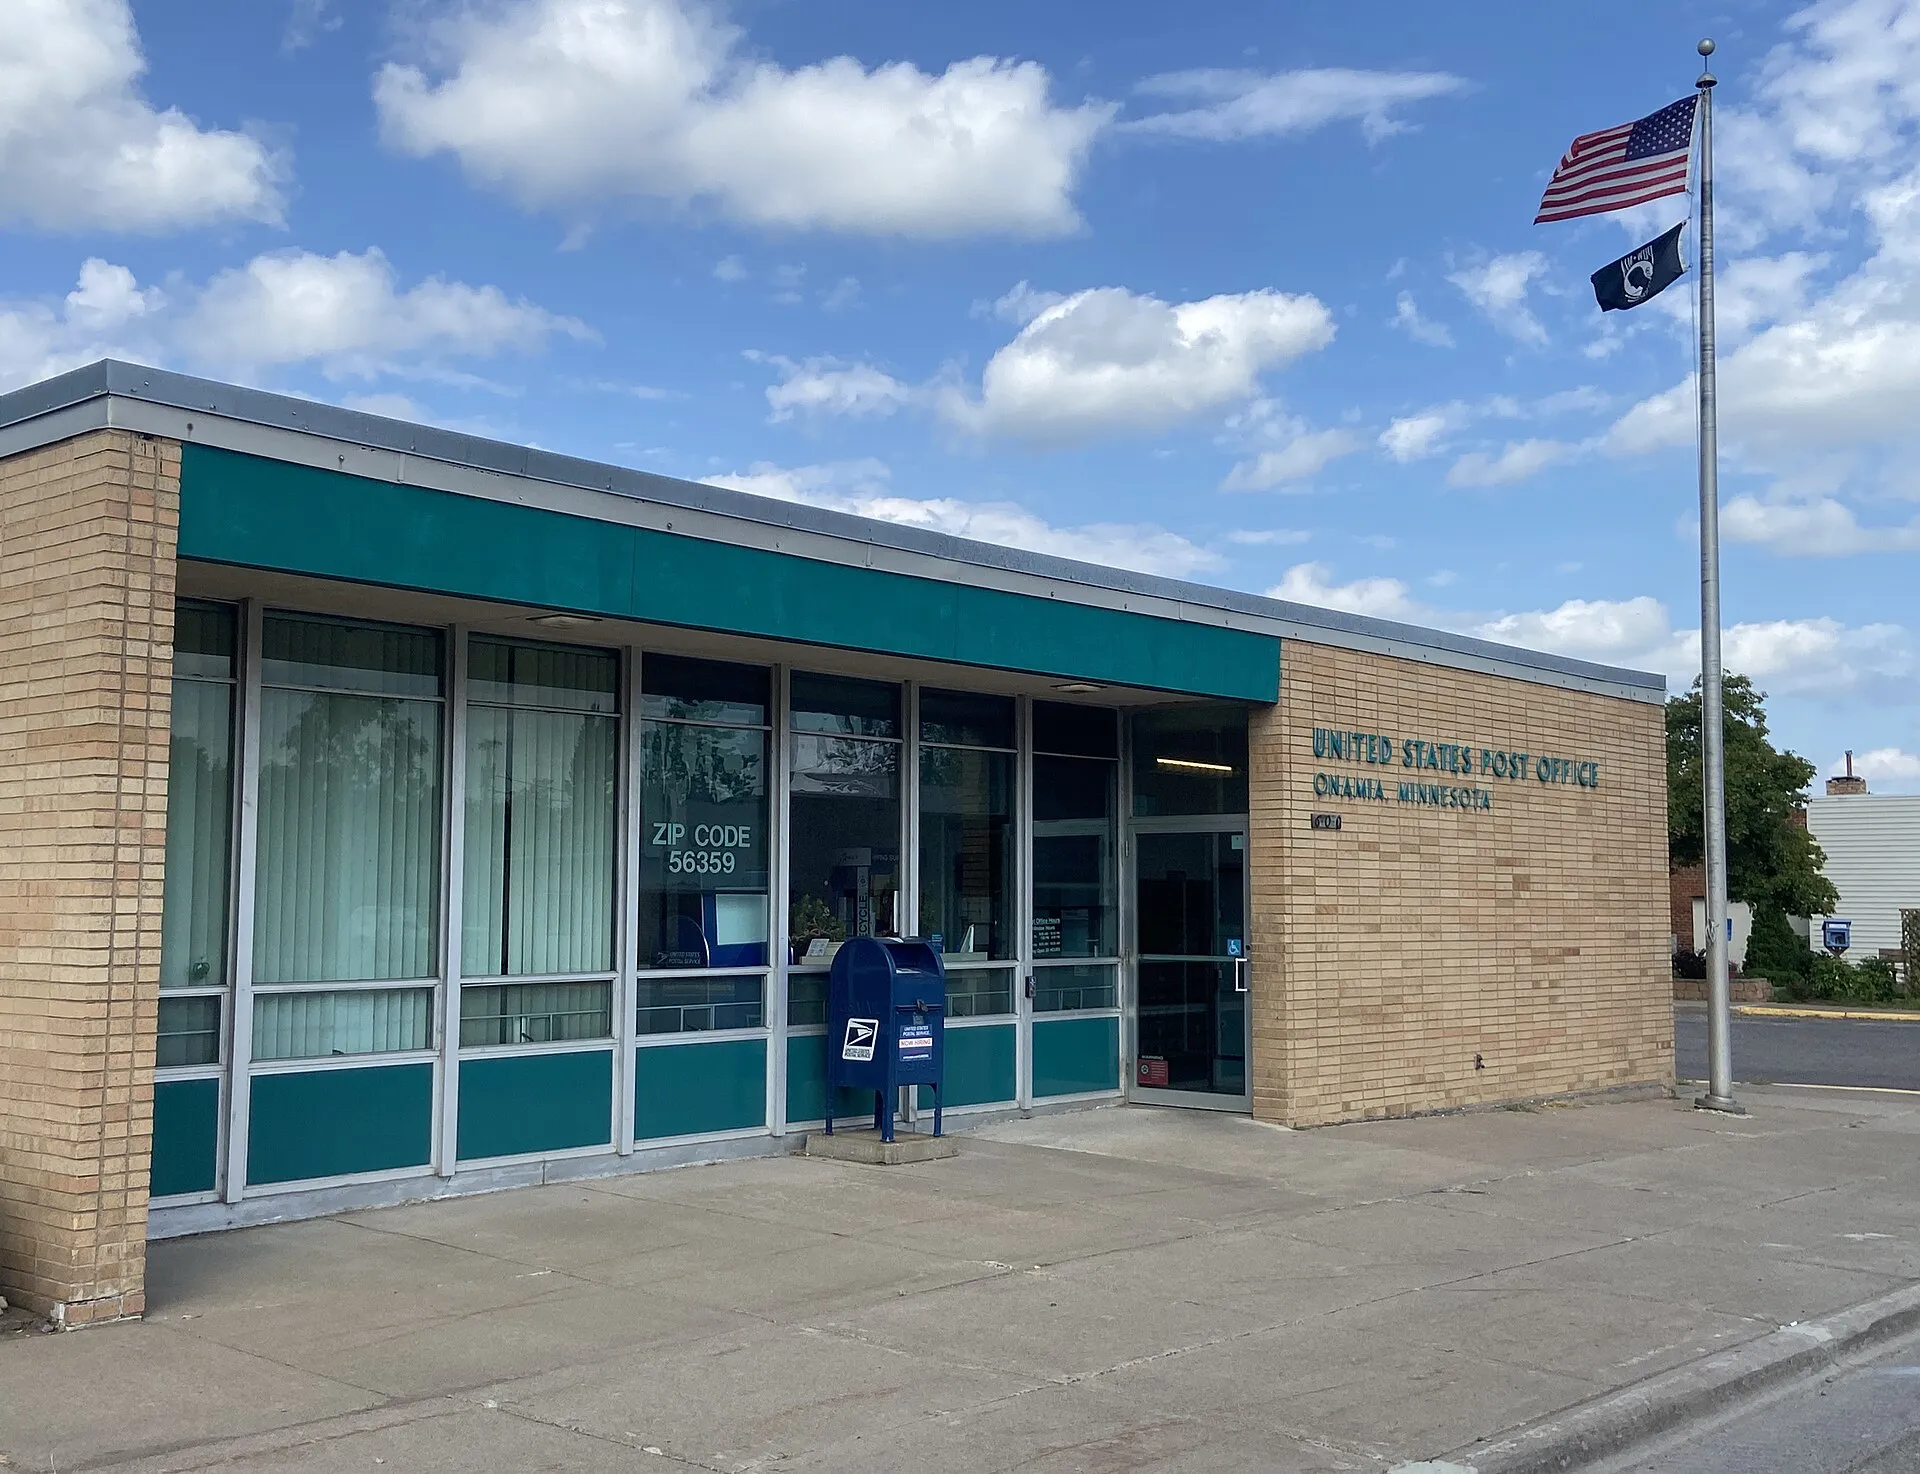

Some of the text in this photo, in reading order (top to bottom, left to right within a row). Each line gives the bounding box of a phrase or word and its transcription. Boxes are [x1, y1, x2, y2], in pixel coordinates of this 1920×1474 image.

[1313, 727, 1599, 788] UNITED STATES POST OFFICE
[1397, 779, 1491, 811] MINNESOTA
[652, 822, 751, 848] ZIP CODE
[668, 850, 735, 874] 56359
